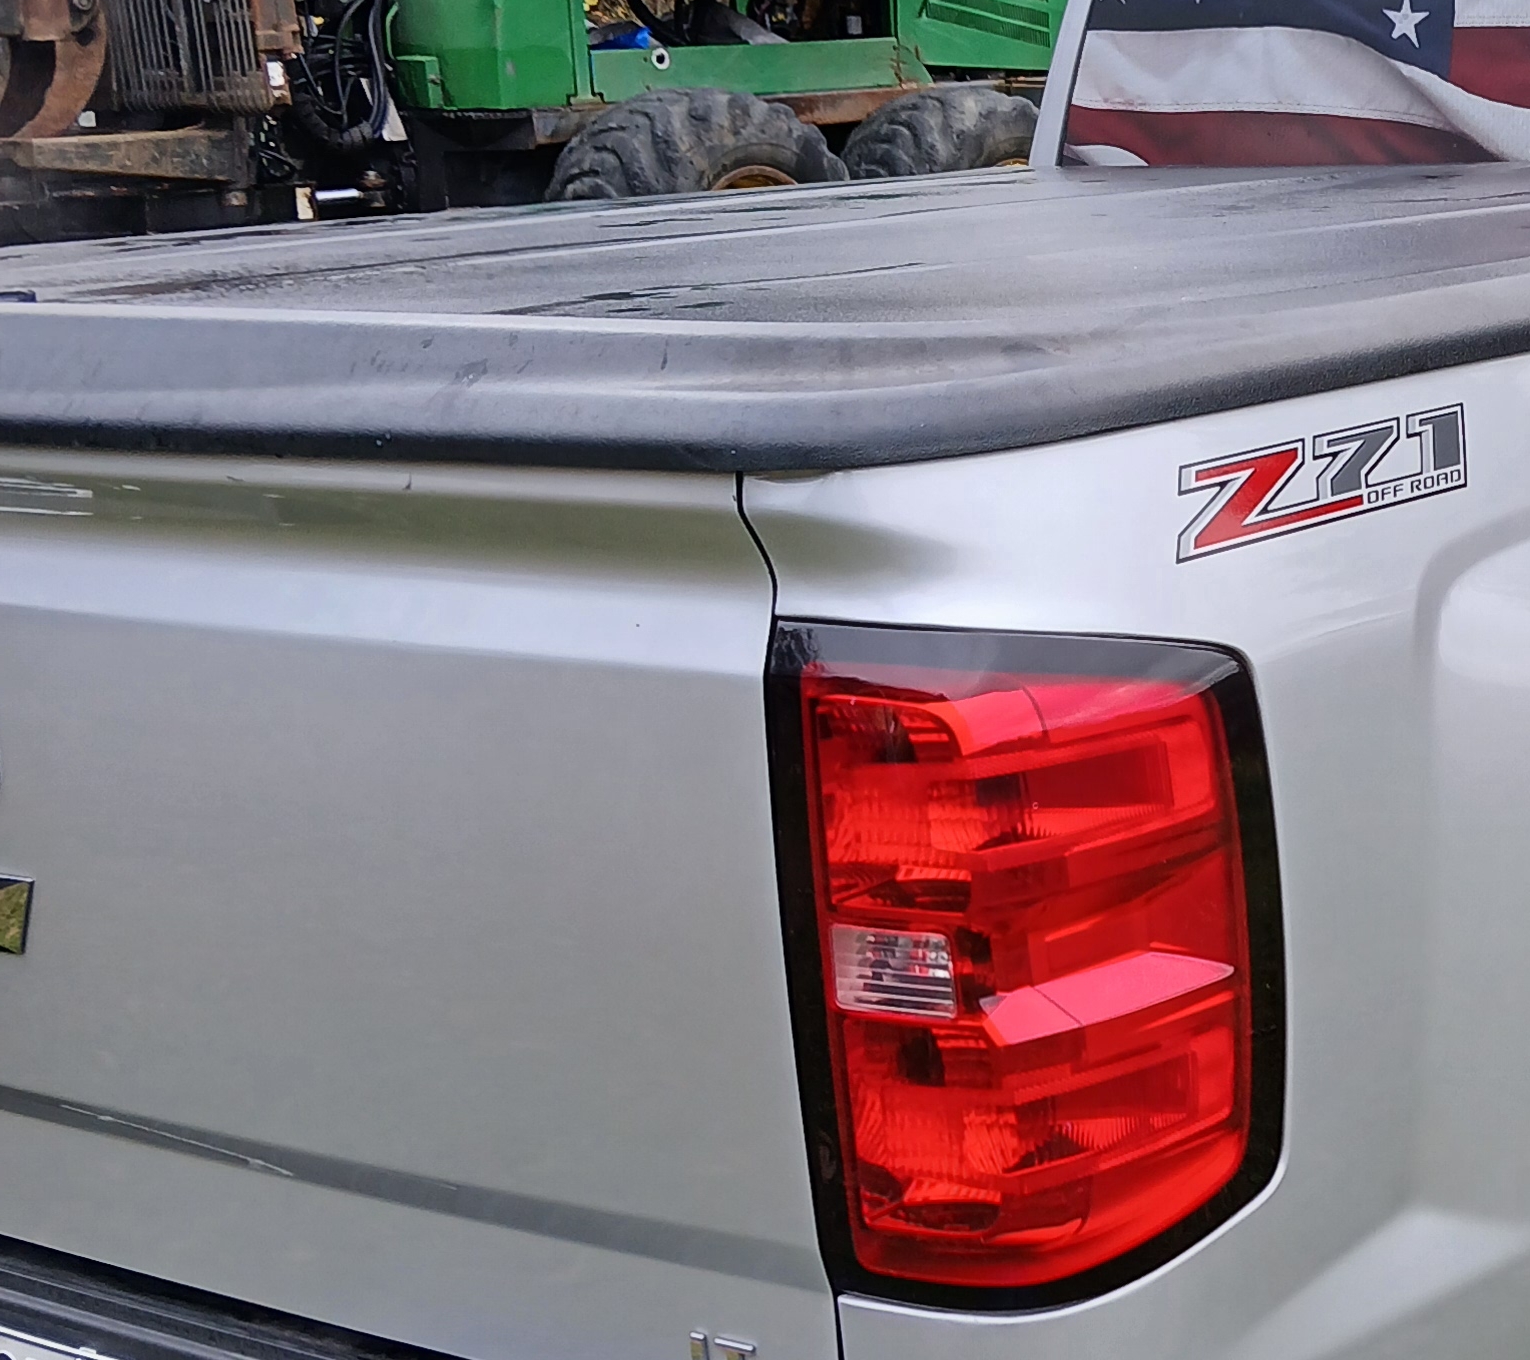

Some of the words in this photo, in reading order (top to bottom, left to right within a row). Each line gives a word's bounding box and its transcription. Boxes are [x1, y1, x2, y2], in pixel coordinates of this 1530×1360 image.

[1176, 402, 1468, 564] Z71
[1367, 484, 1404, 505] OFF
[1410, 468, 1463, 494] ROAD
